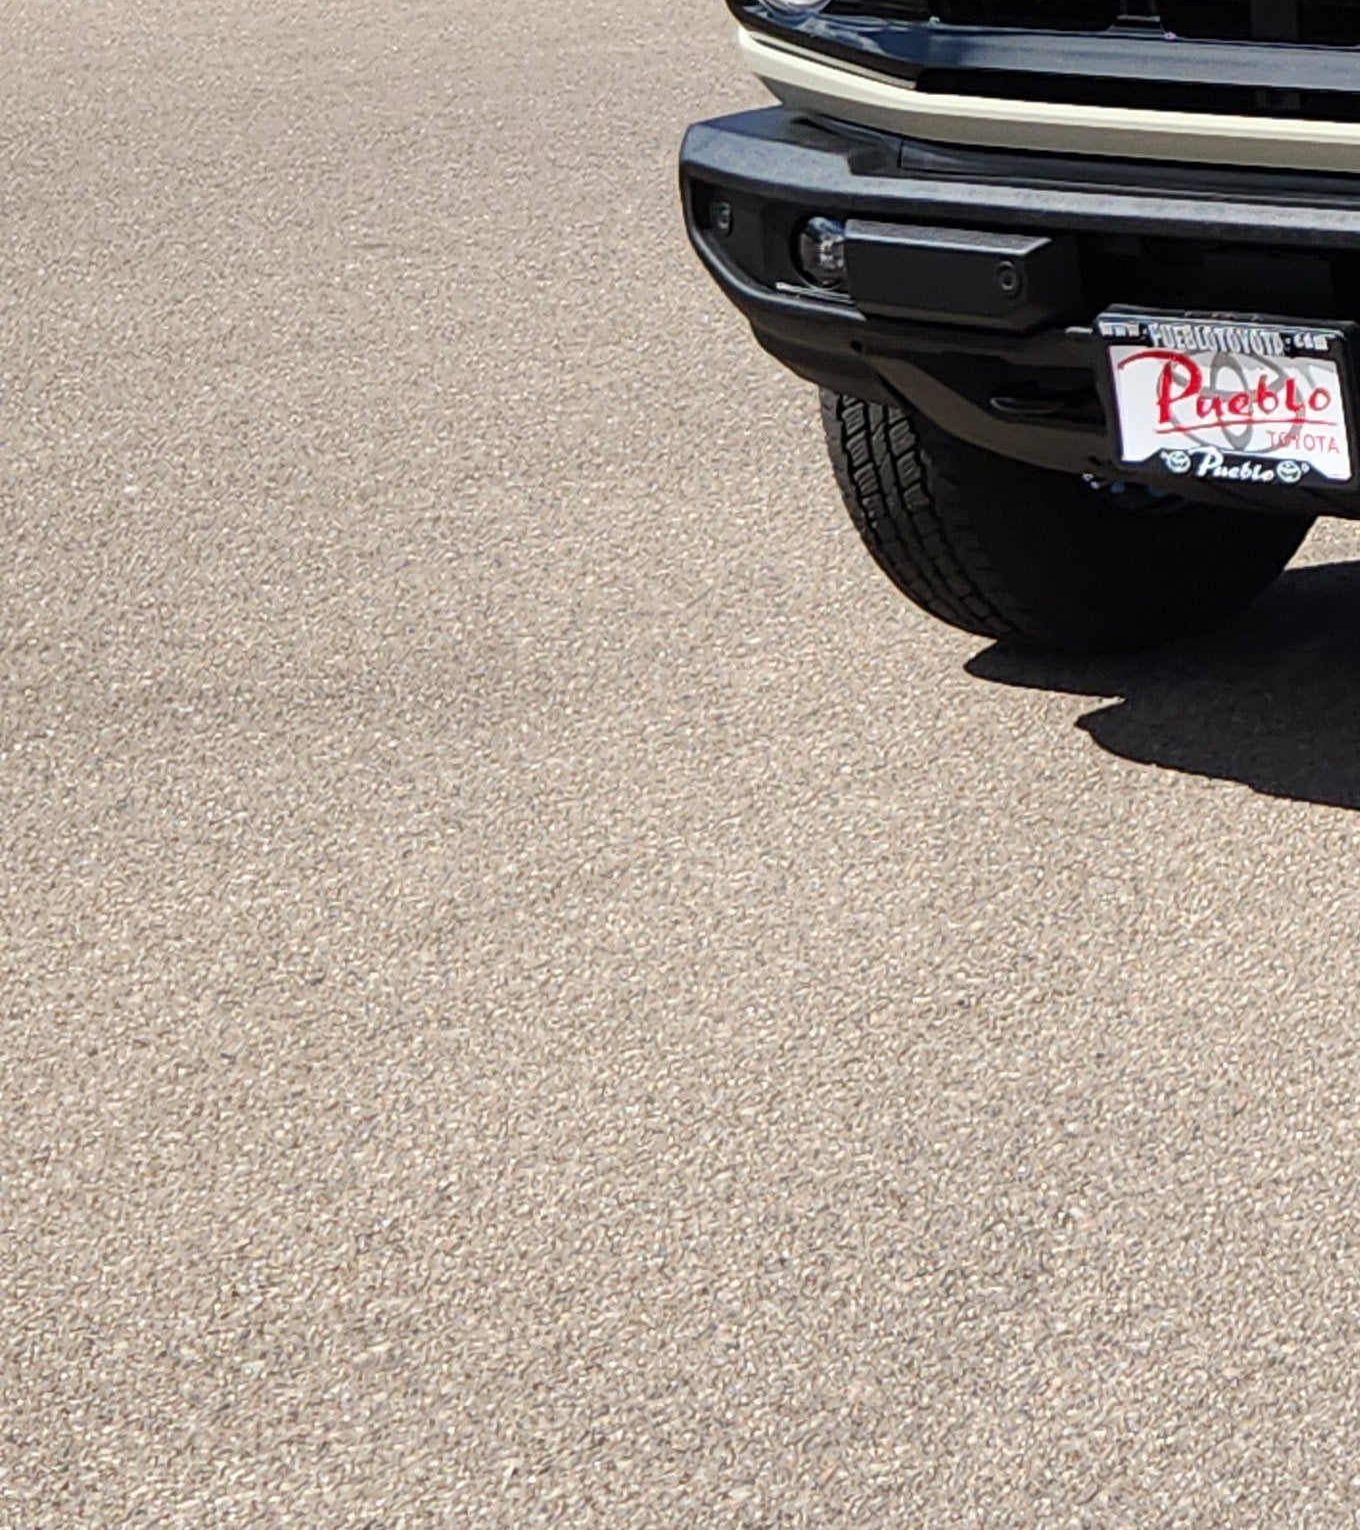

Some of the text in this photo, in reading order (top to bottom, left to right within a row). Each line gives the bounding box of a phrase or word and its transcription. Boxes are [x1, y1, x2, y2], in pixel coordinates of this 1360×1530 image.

[1118, 350, 1331, 424] Pueblo
[1266, 430, 1341, 454] TOYOTA
[1189, 446, 1275, 480] Pueblo
